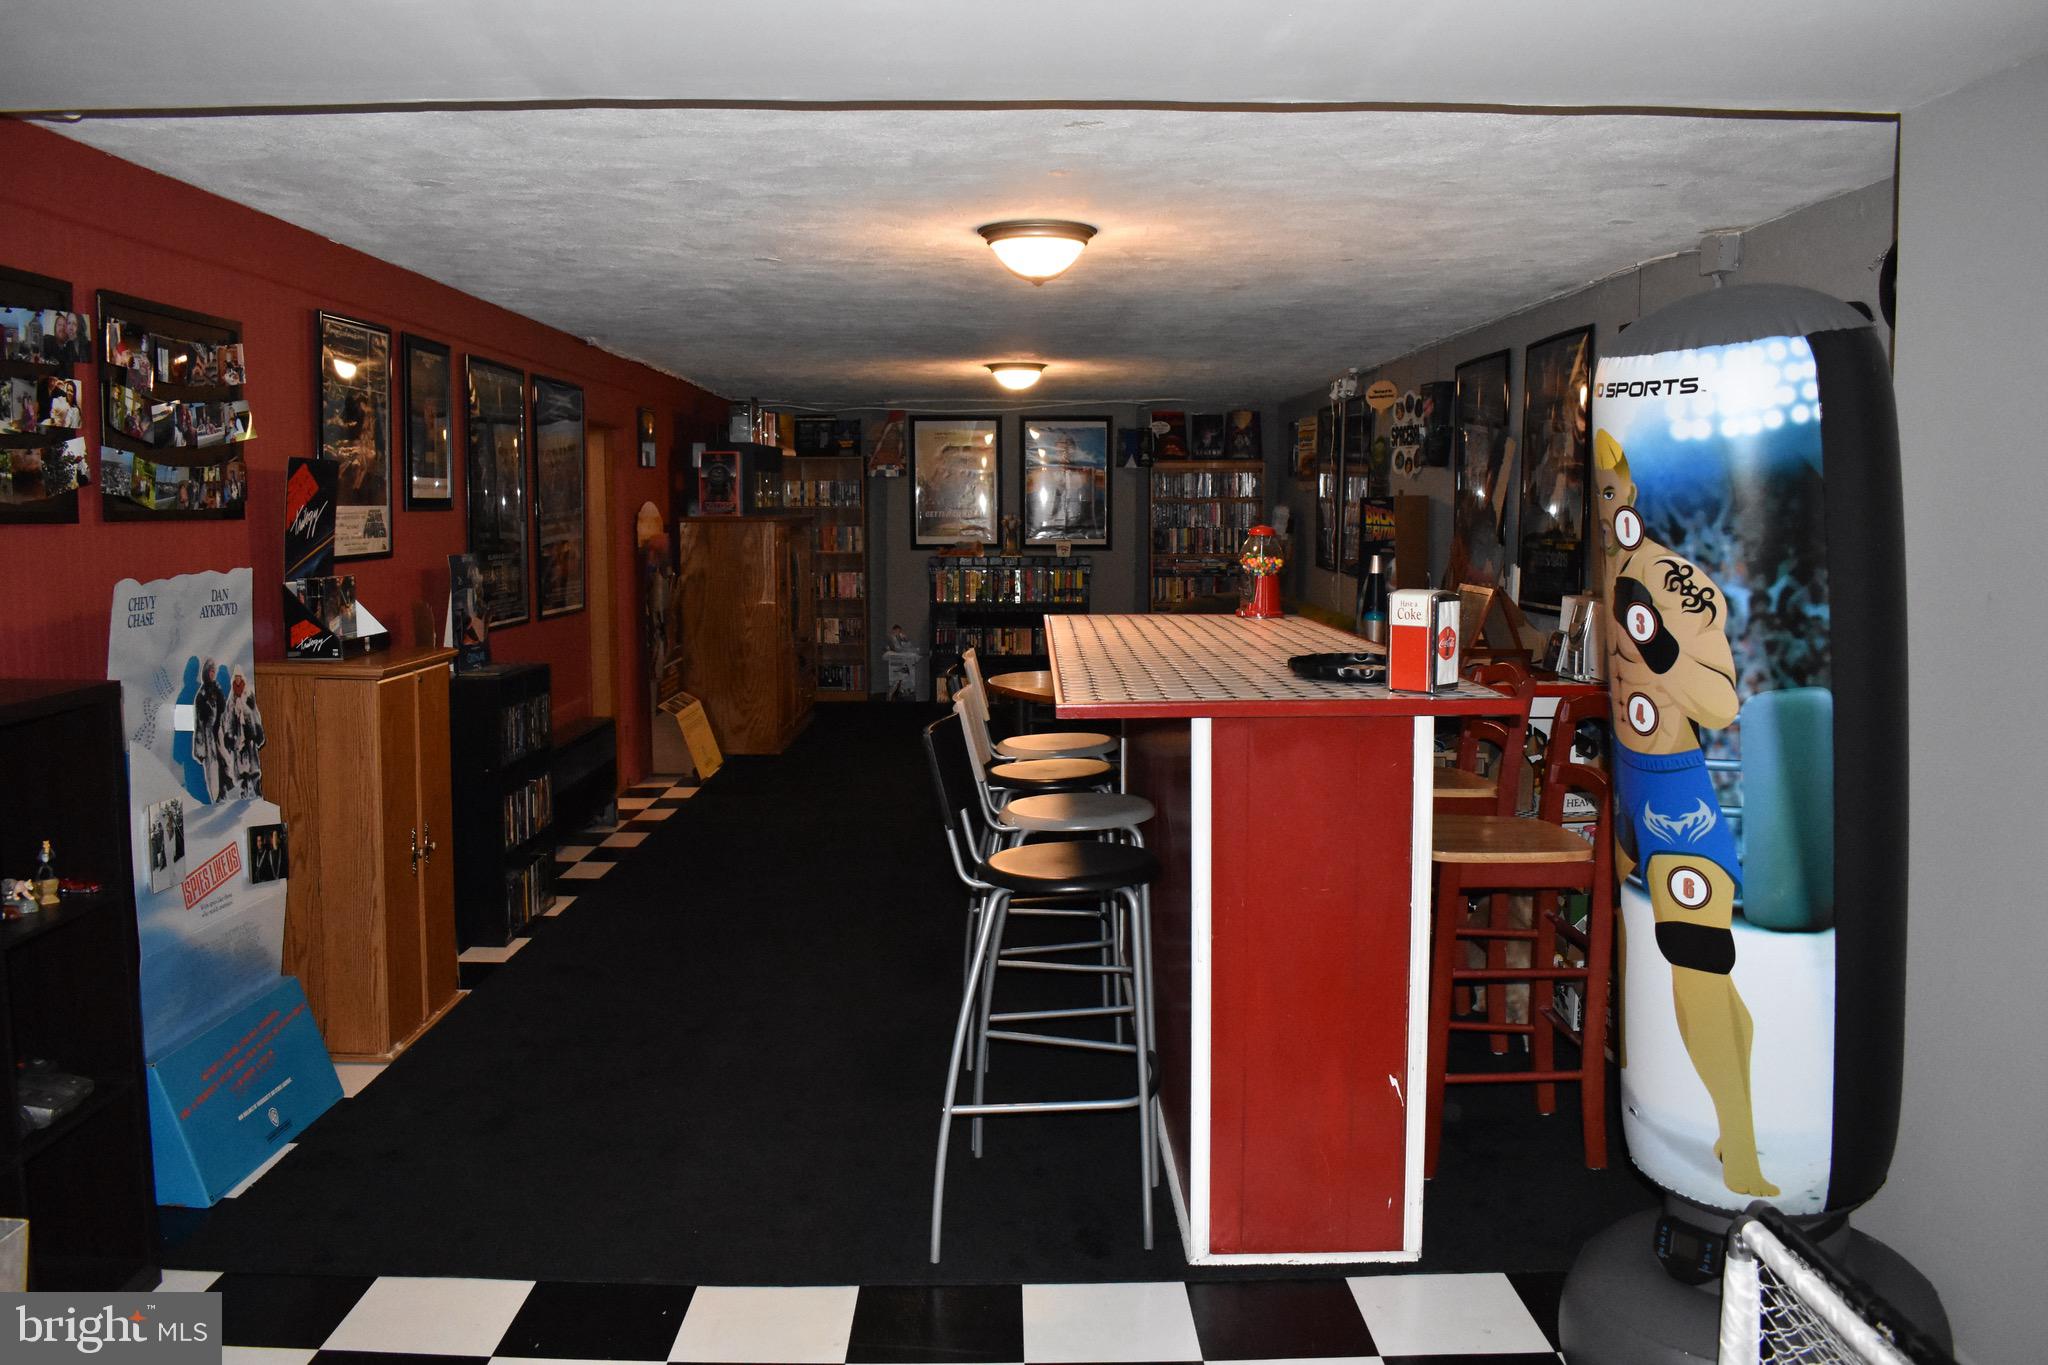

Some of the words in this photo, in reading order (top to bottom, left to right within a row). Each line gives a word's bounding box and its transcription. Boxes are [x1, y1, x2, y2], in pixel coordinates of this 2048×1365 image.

[1606, 377, 1699, 399] SPORTS
[1624, 516, 1630, 538] 1
[128, 595, 156, 612] CHEVY
[211, 588, 229, 602] DAN
[127, 612, 155, 629] CHASE
[199, 602, 238, 619] AYKROYD
[1397, 607, 1422, 621] Coke
[1636, 613, 1646, 635] 3
[1636, 703, 1646, 725] 4
[184, 867, 211, 905] SPIES
[209, 855, 229, 886] LIKE
[226, 847, 240, 873] US
[1683, 877, 1695, 899] 6
